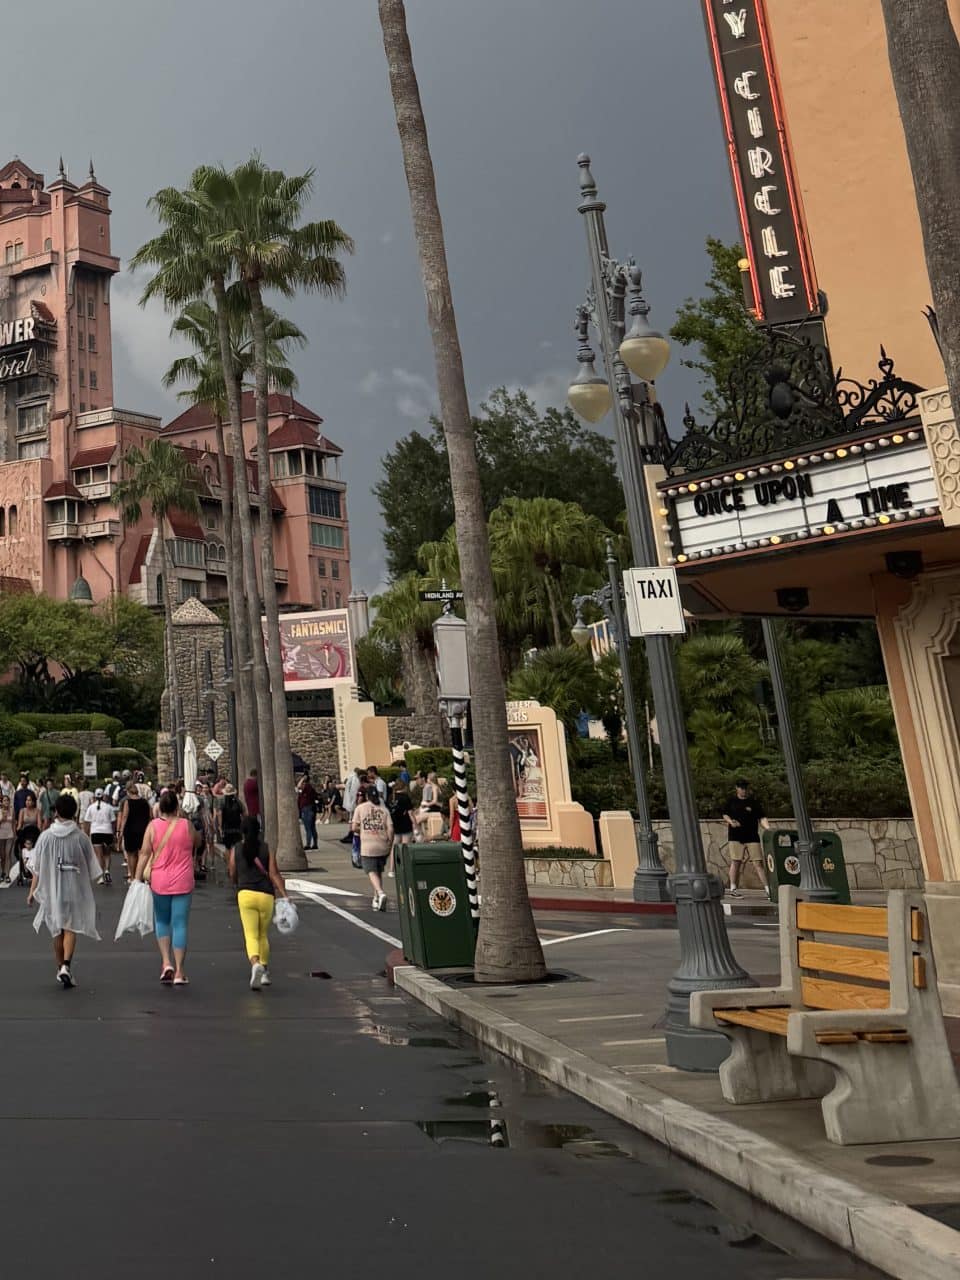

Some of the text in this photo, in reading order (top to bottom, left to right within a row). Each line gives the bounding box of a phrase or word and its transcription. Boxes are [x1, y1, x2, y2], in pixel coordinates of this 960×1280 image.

[734, 70, 796, 299] CIRCLE
[693, 473, 814, 517] ONCE UPON
[826, 481, 913, 523] A TIME
[424, 591, 455, 599] HIGHLAND
[637, 578, 673, 599] TAXI
[290, 620, 346, 638] FANTASMIC!
